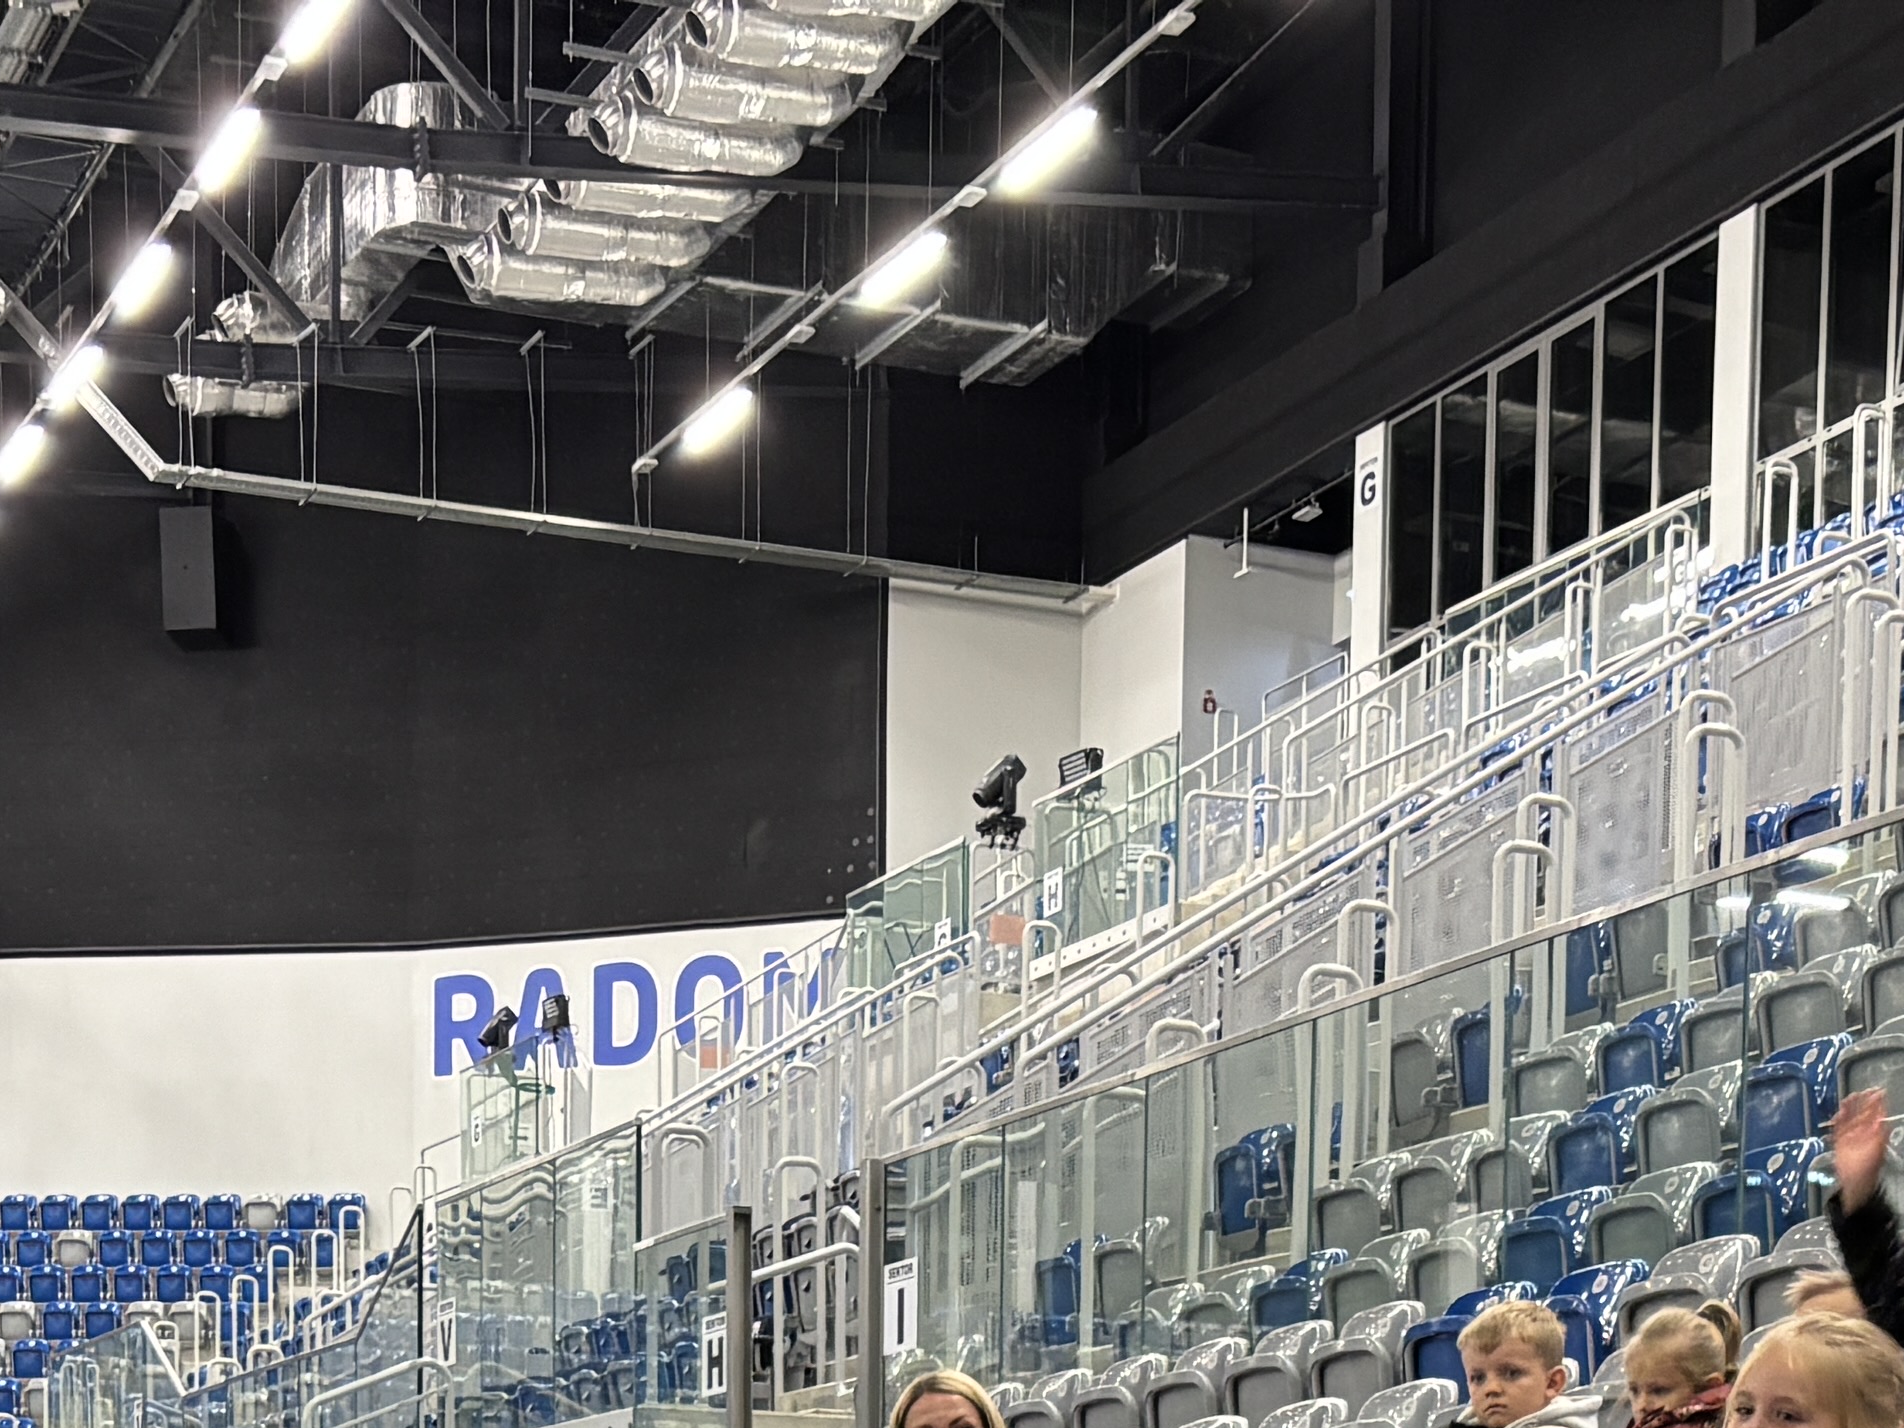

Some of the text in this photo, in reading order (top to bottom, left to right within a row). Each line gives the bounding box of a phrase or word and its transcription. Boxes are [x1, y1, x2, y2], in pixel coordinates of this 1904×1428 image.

[1360, 471, 1377, 507] G
[1047, 881, 1059, 912] H
[887, 1262, 914, 1280] SEKTOR
[897, 1287, 905, 1345] I
[440, 1318, 452, 1361] V
[707, 1336, 724, 1390] H
